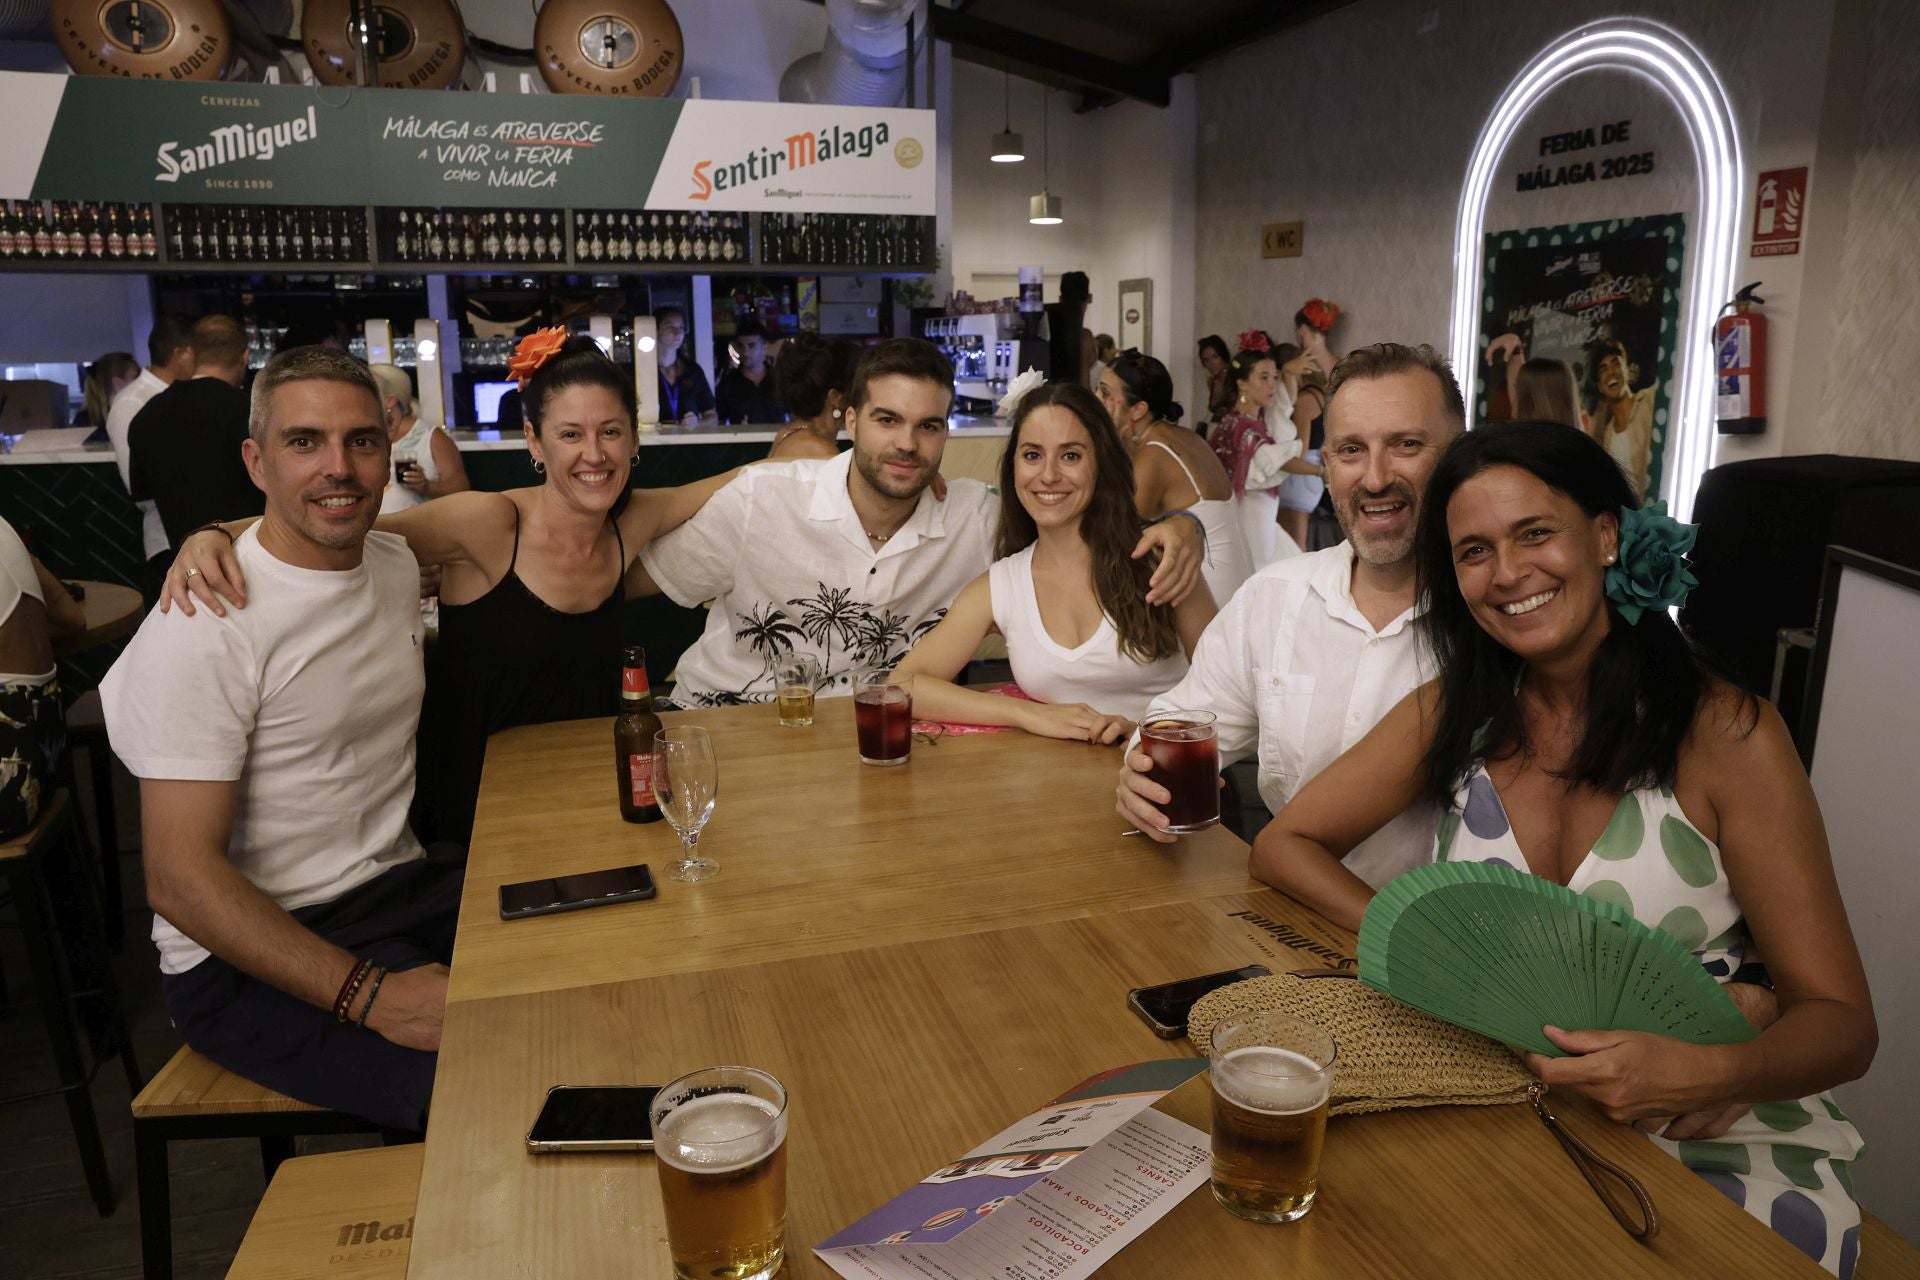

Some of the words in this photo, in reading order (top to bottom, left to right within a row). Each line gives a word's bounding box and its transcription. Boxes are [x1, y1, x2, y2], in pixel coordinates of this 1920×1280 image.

[169, 35, 218, 79] BODEGA
[408, 41, 450, 86] BODEGA
[546, 45, 602, 92] CERVEZA
[611, 85, 628, 94] DE
[633, 49, 674, 90] BODEGA
[200, 96, 260, 107] CERVEZAS
[383, 115, 470, 139] MÁLAGA
[490, 121, 605, 144] ATREVERSE
[1539, 128, 1596, 157] FERIA
[1600, 120, 1632, 145] DE
[418, 148, 428, 159] A
[436, 144, 491, 166] VIVIR
[495, 150, 508, 161] LA
[514, 146, 574, 166] FERIA
[205, 178, 239, 188] SINCE
[244, 179, 273, 189] 1890
[443, 169, 481, 182] COMO
[488, 166, 558, 188] NUNCA
[1516, 164, 1596, 192] MÁLAGA
[1600, 151, 1654, 180] 2025
[1562, 275, 1634, 309] ATREVERSE
[1577, 303, 1614, 323] FERIA
[1136, 1165, 1175, 1187] CARNES
[1074, 1195, 1126, 1227] PESCADOS
[1028, 1216, 1090, 1255] BOCADILLOS
